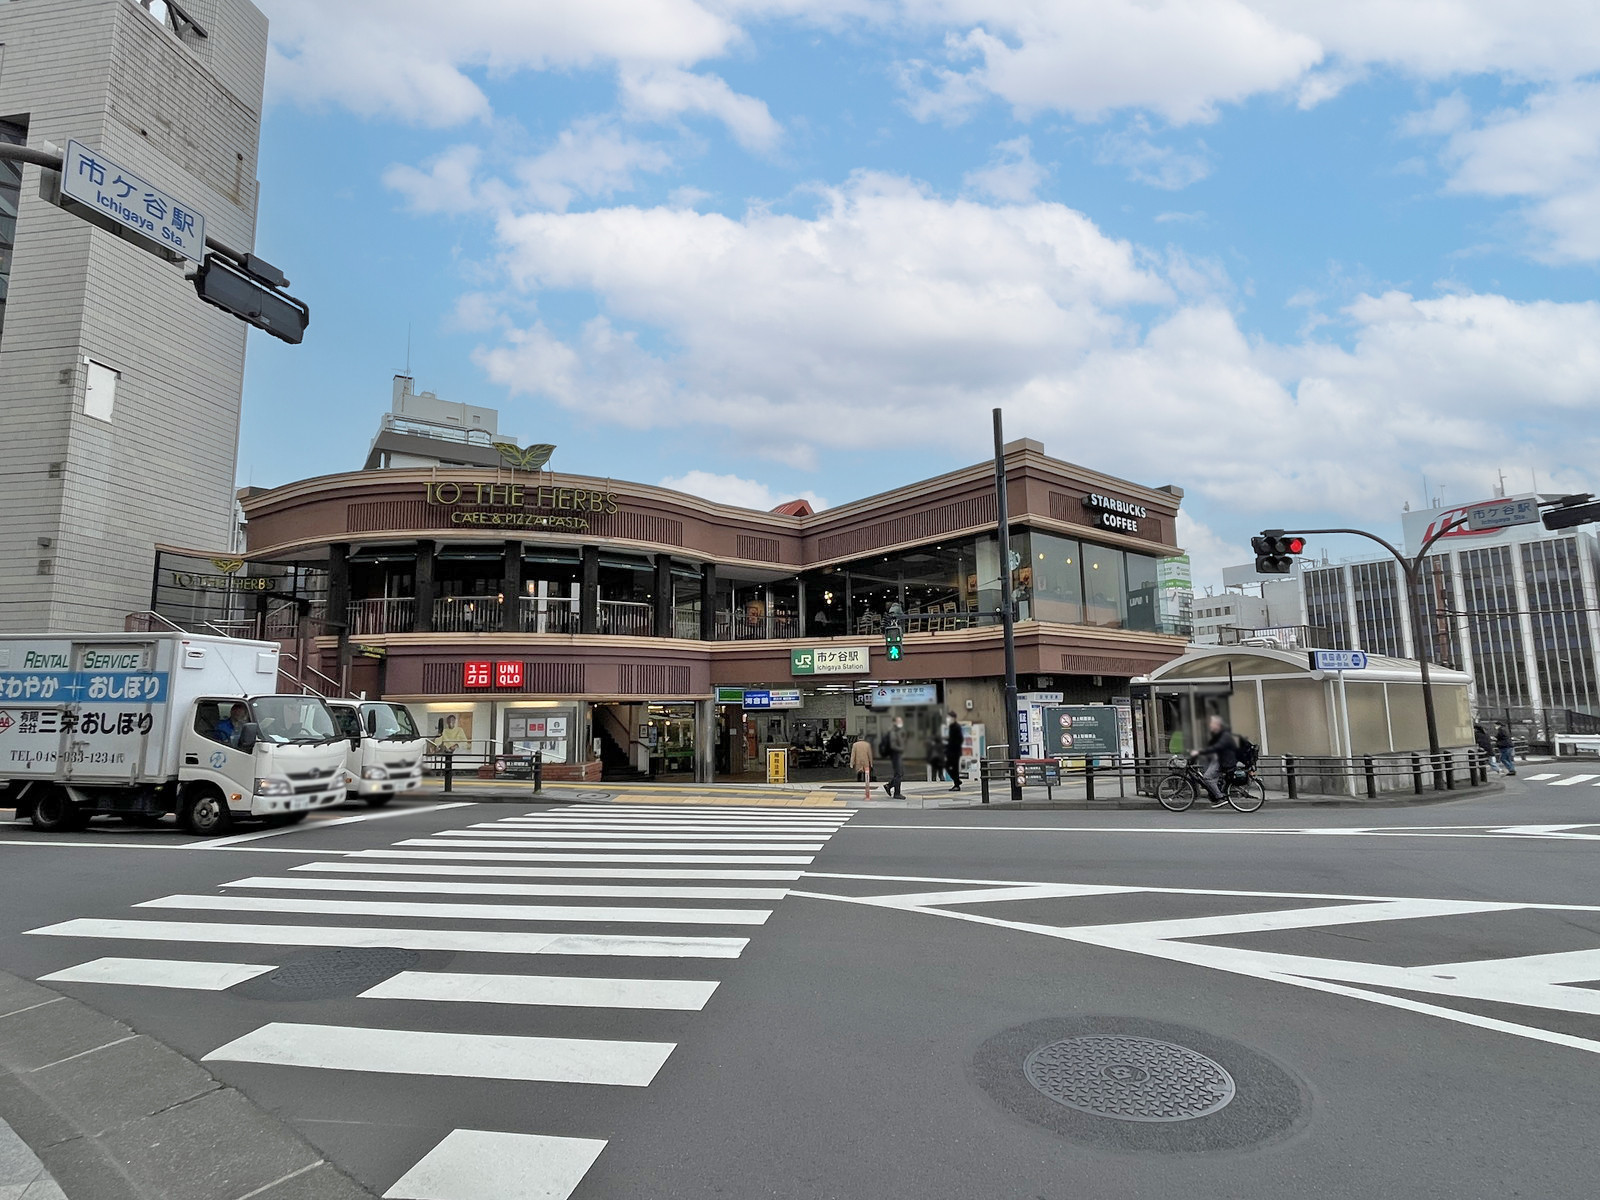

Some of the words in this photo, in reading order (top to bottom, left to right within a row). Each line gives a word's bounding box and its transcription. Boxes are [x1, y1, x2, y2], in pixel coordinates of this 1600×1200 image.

[97, 190, 154, 231] Ichigaya
[162, 226, 186, 249] Sta.
[423, 482, 461, 505] TO
[473, 483, 525, 506] THE
[538, 486, 618, 514] HERBS
[1091, 494, 1146, 518] STARBUCKS
[451, 511, 488, 524] CAFE
[492, 514, 501, 524] &
[1103, 513, 1137, 531] COFFEE
[23, 650, 69, 669] RENTAL
[83, 650, 139, 669] SERVICE
[794, 654, 812, 665] JR
[817, 651, 859, 662] 市ケ谷駅
[88, 676, 160, 699] おしぼり
